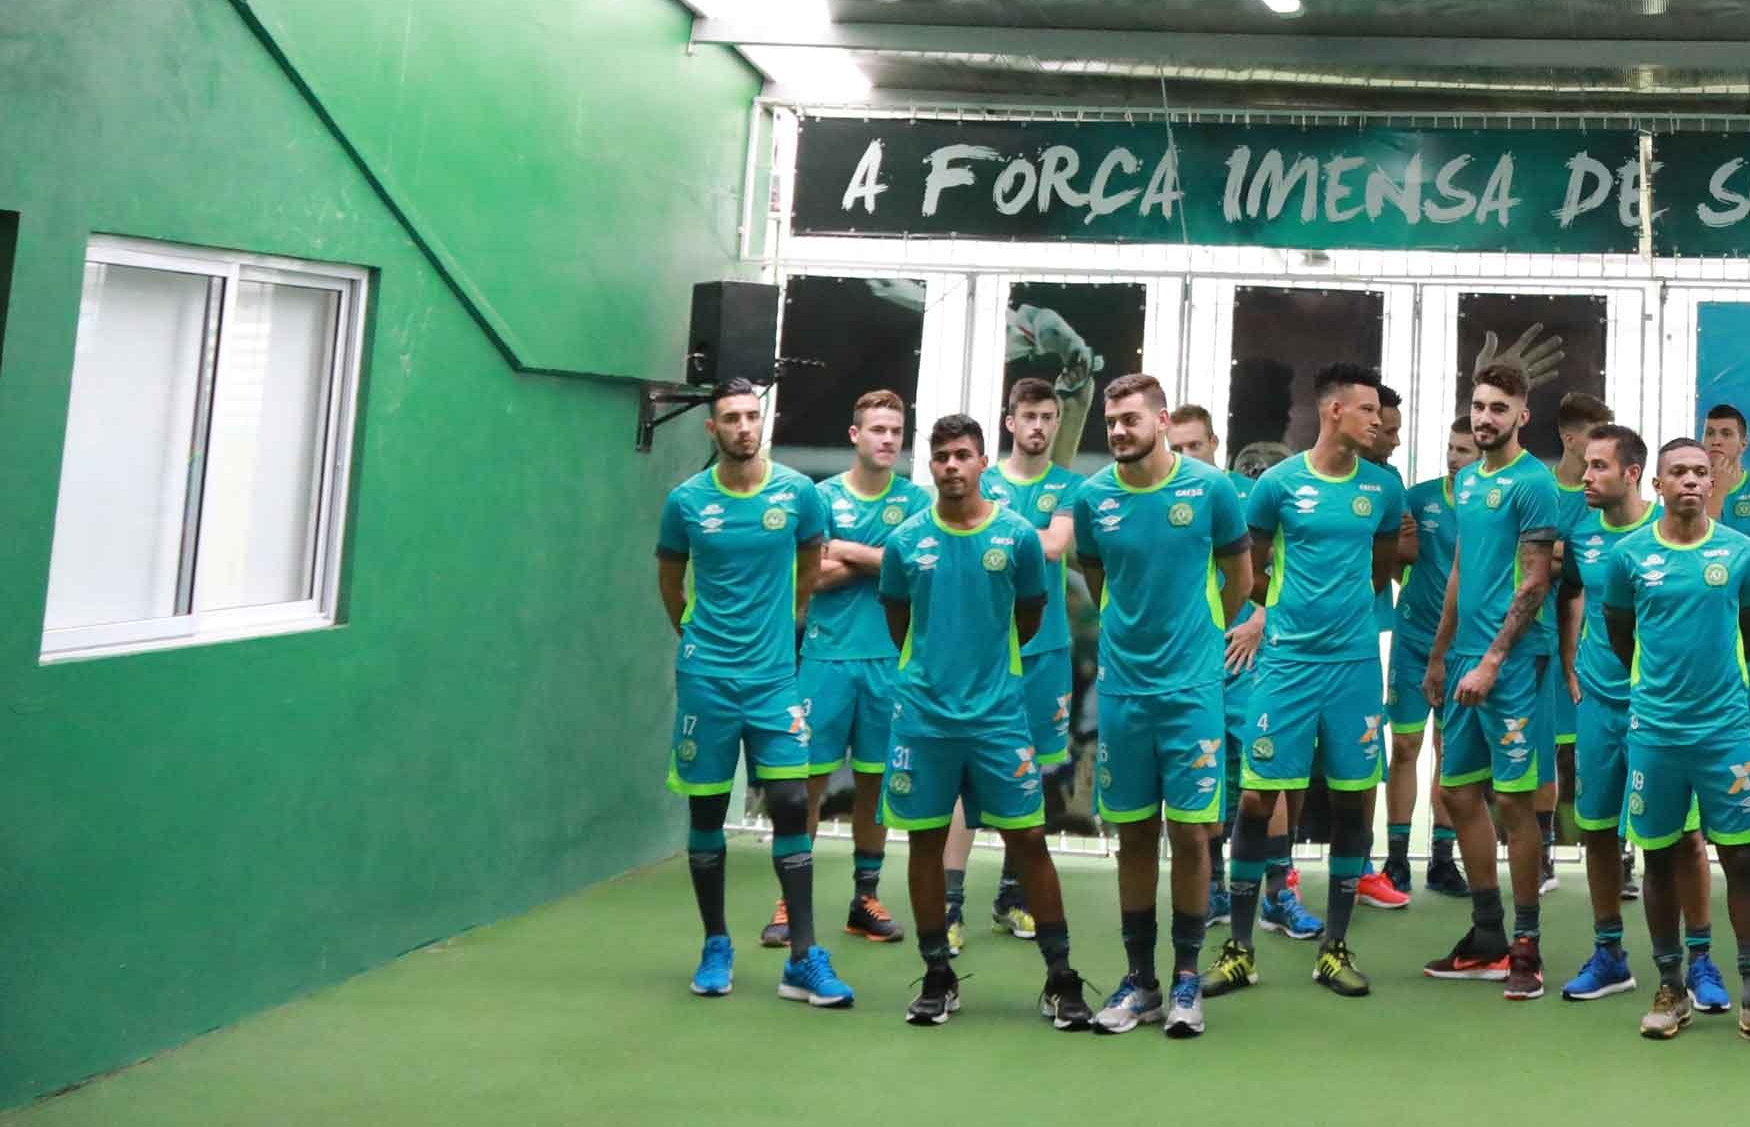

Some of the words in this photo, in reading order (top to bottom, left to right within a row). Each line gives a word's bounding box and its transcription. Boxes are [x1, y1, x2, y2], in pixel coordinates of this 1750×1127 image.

[841, 137, 888, 215] A
[1223, 144, 1521, 228] IMENSA
[1551, 150, 1670, 229] DE
[682, 713, 698, 736] 17
[1257, 712, 1269, 732] 4
[892, 744, 913, 771] 31
